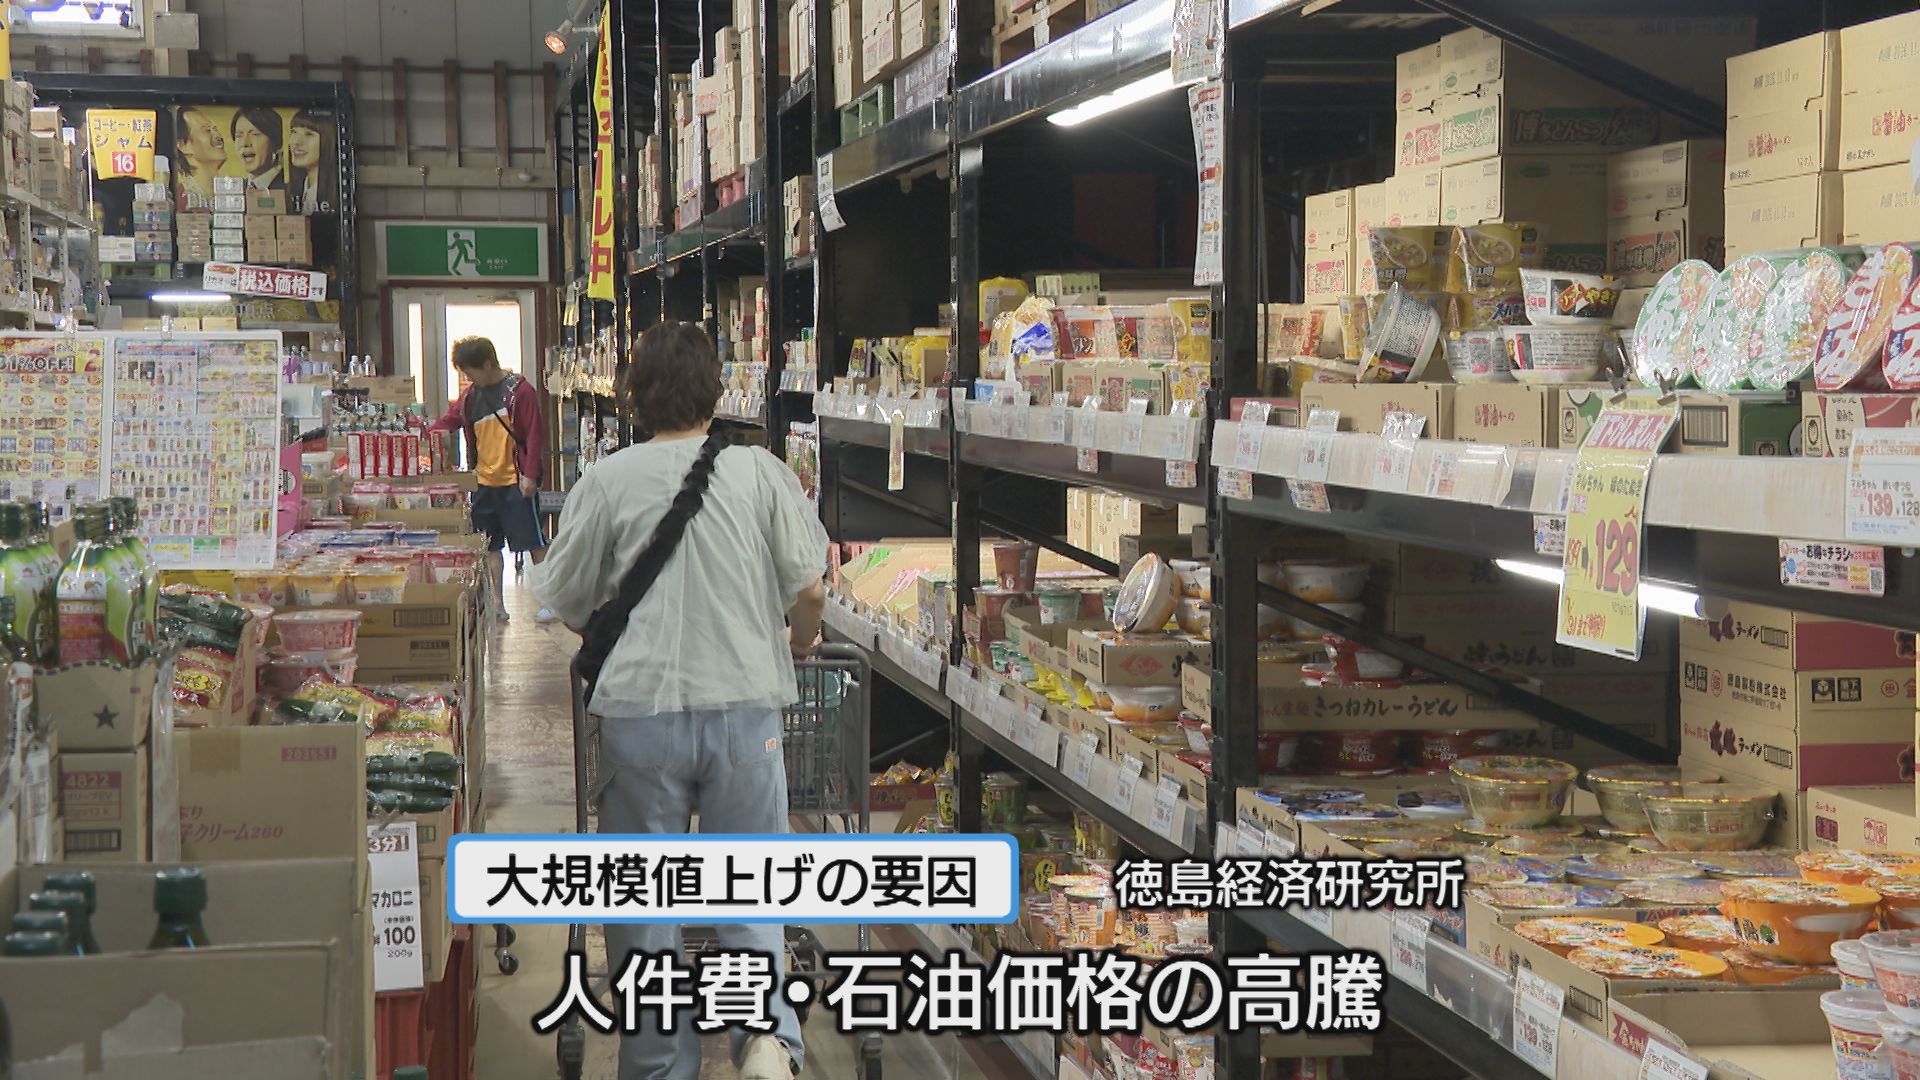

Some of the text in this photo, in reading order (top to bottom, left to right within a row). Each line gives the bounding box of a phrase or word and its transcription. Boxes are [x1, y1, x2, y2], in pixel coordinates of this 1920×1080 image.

[94, 118, 153, 133] コーヒー・紅茶
[95, 134, 153, 149] ジャム
[113, 154, 135, 173] 16
[240, 269, 308, 297] 税込価格
[1596, 519, 1638, 596] 129
[65, 774, 109, 789] 4822
[372, 890, 413, 908] マカロニ
[384, 926, 415, 946] 100
